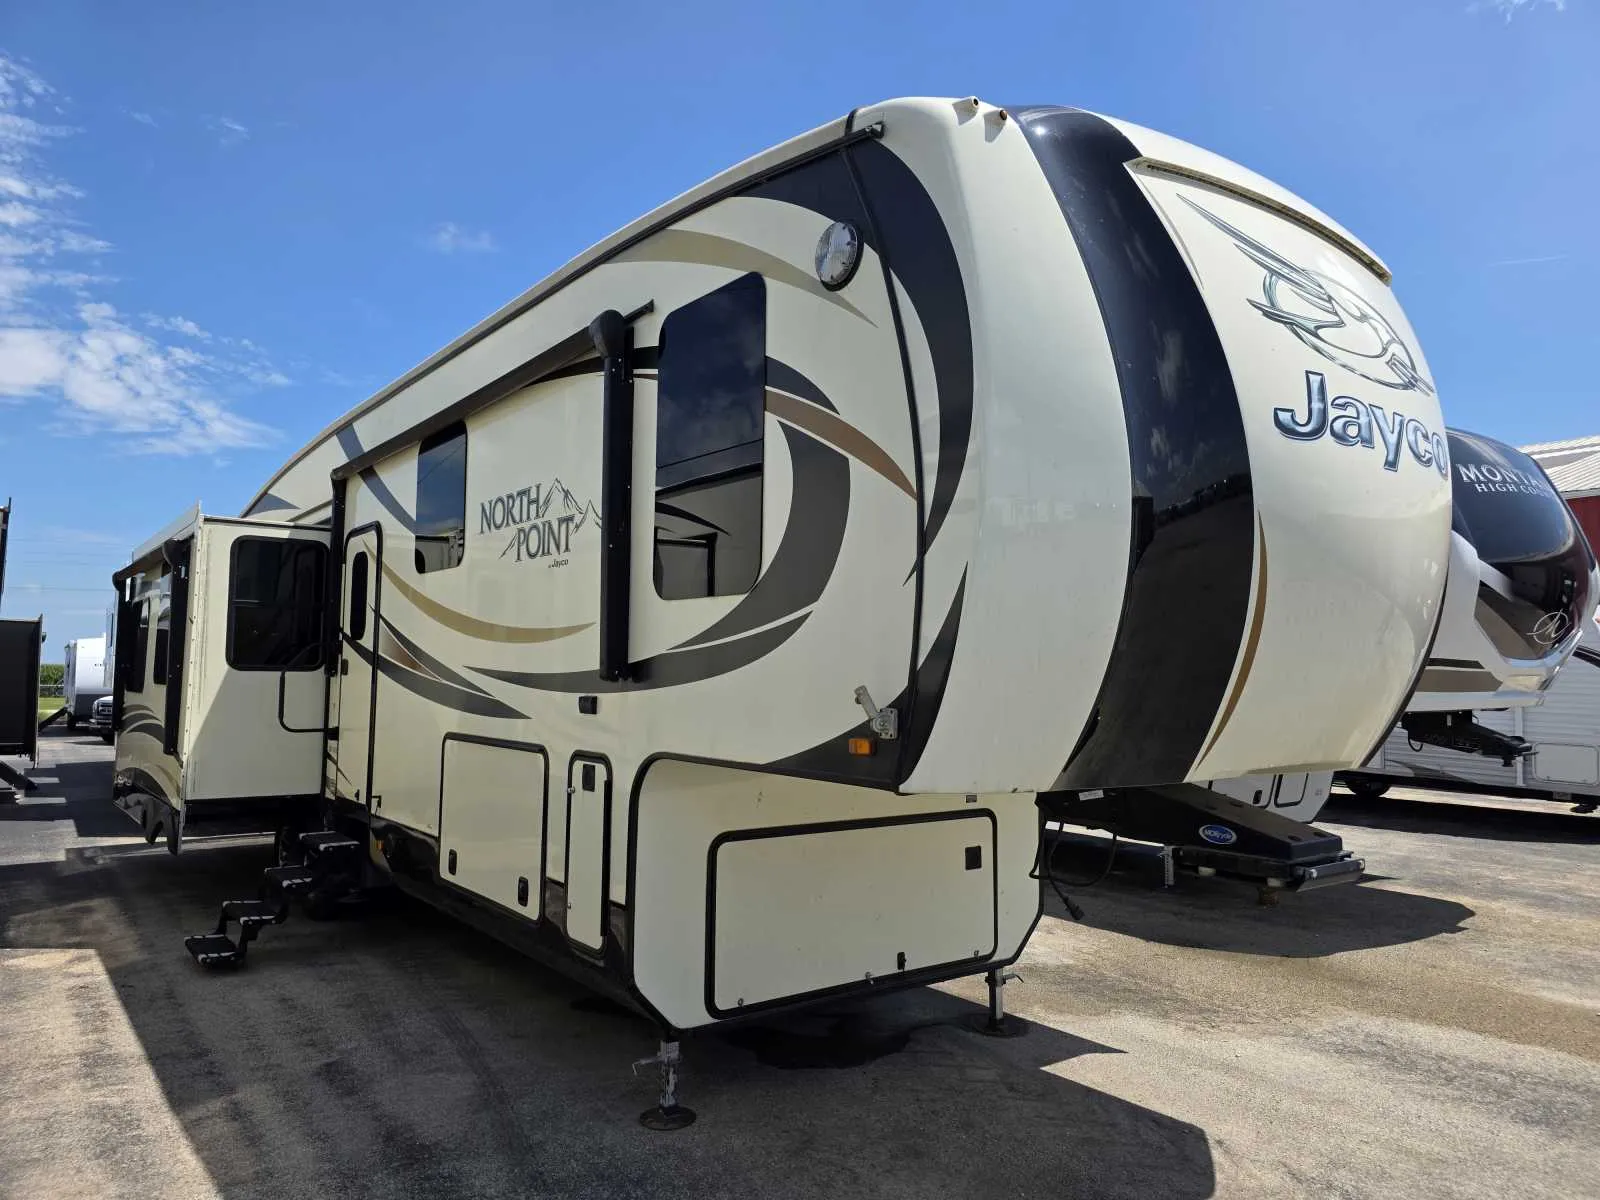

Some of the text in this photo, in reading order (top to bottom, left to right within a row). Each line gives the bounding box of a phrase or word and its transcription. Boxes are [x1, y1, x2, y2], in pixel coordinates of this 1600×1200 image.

[1273, 369, 1449, 480] Jayco
[479, 483, 542, 535] NORTH
[1475, 483, 1518, 493] HIGH
[514, 514, 575, 562] POINT
